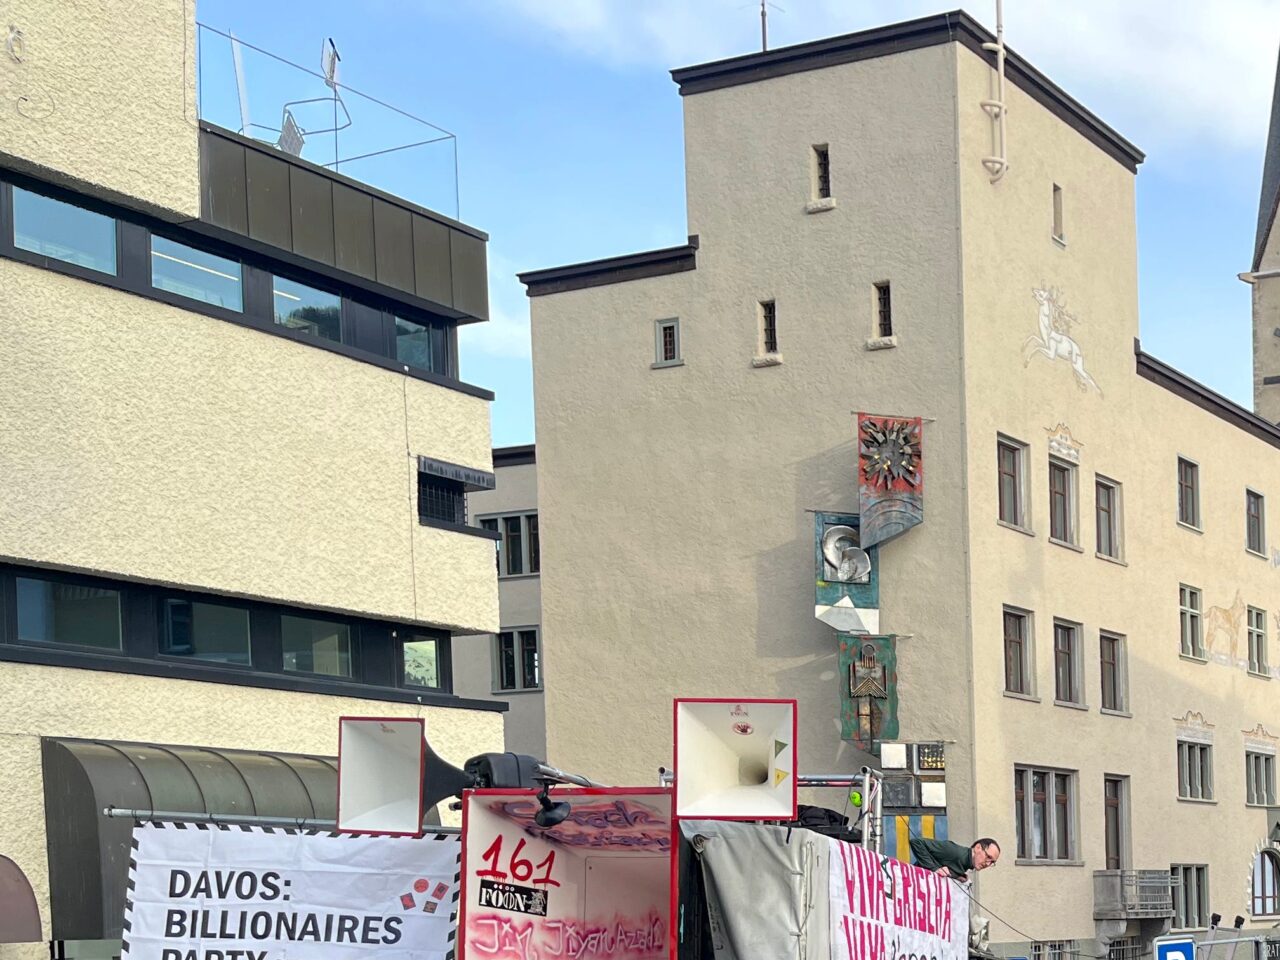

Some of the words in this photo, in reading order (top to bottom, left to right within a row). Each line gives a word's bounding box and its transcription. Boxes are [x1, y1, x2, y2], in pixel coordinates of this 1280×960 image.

[476, 834, 561, 888] 161
[168, 869, 292, 901] DAVOS:
[838, 840, 889, 924] VIVA
[889, 857, 952, 943] GRISCHA
[164, 909, 403, 945] BILLIONAIRES
